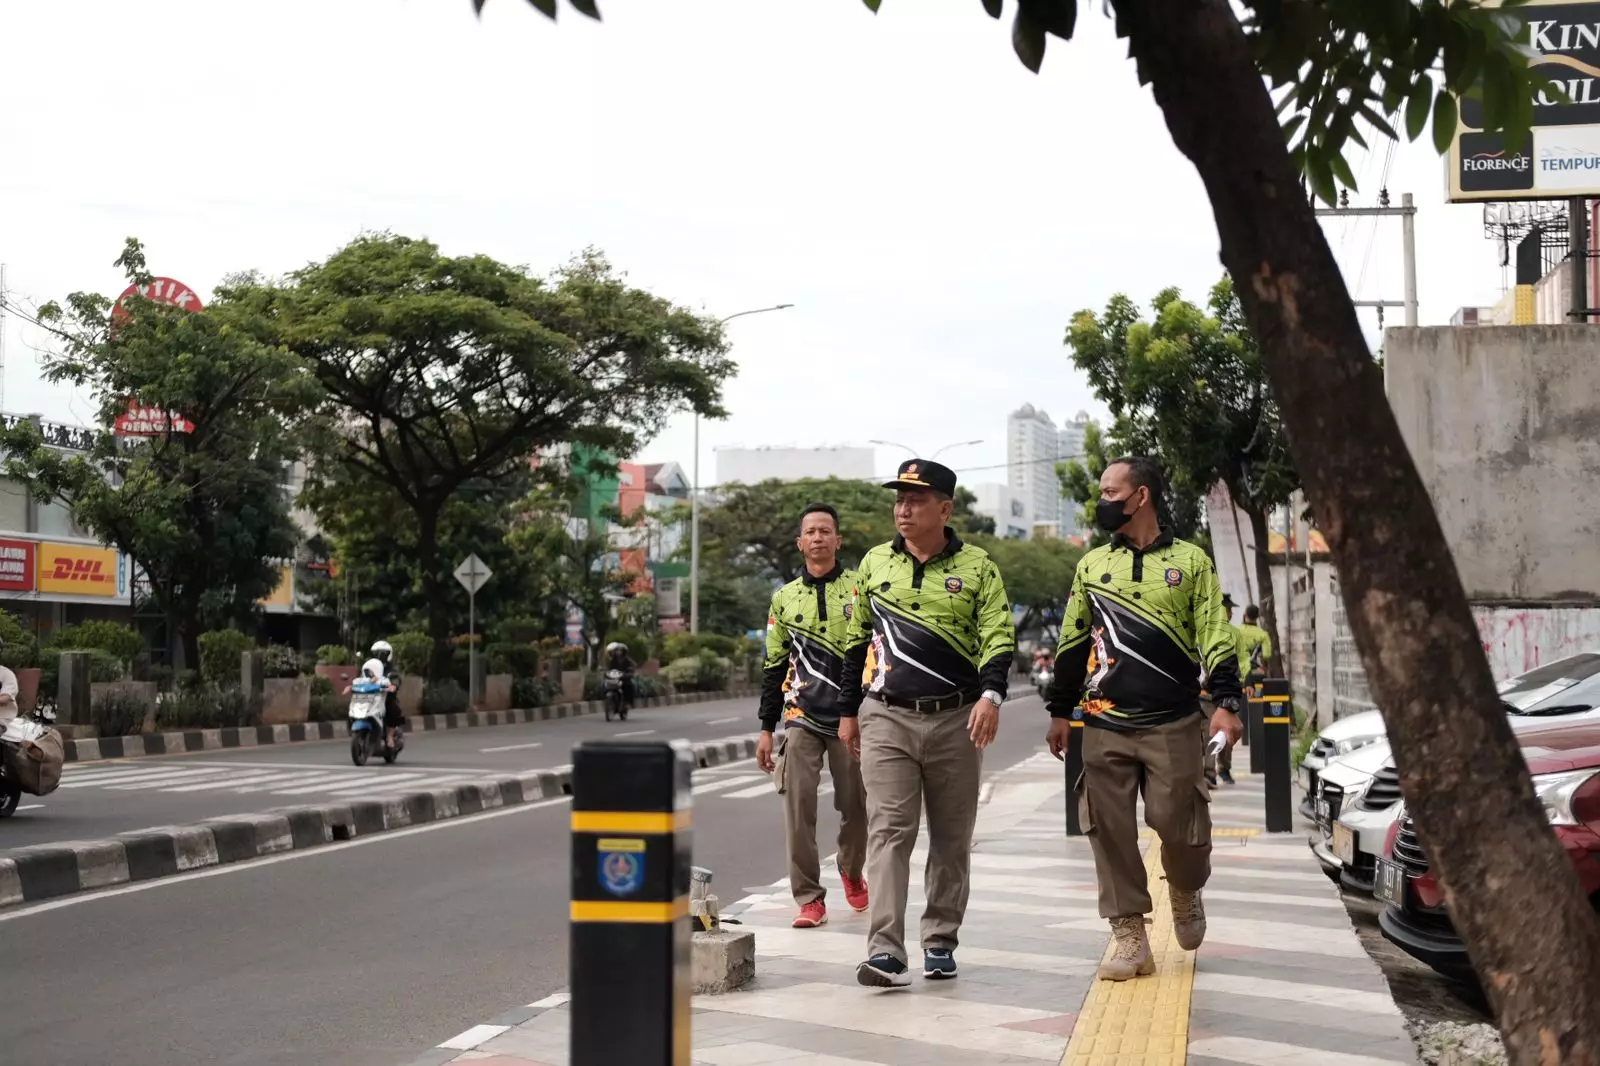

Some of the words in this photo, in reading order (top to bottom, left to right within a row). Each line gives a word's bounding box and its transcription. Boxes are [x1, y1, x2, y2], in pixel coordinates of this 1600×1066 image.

[1528, 20, 1600, 50] KIN
[1530, 78, 1600, 106] OIL
[1463, 156, 1531, 171] FLORENCE
[52, 557, 105, 582] DHL
